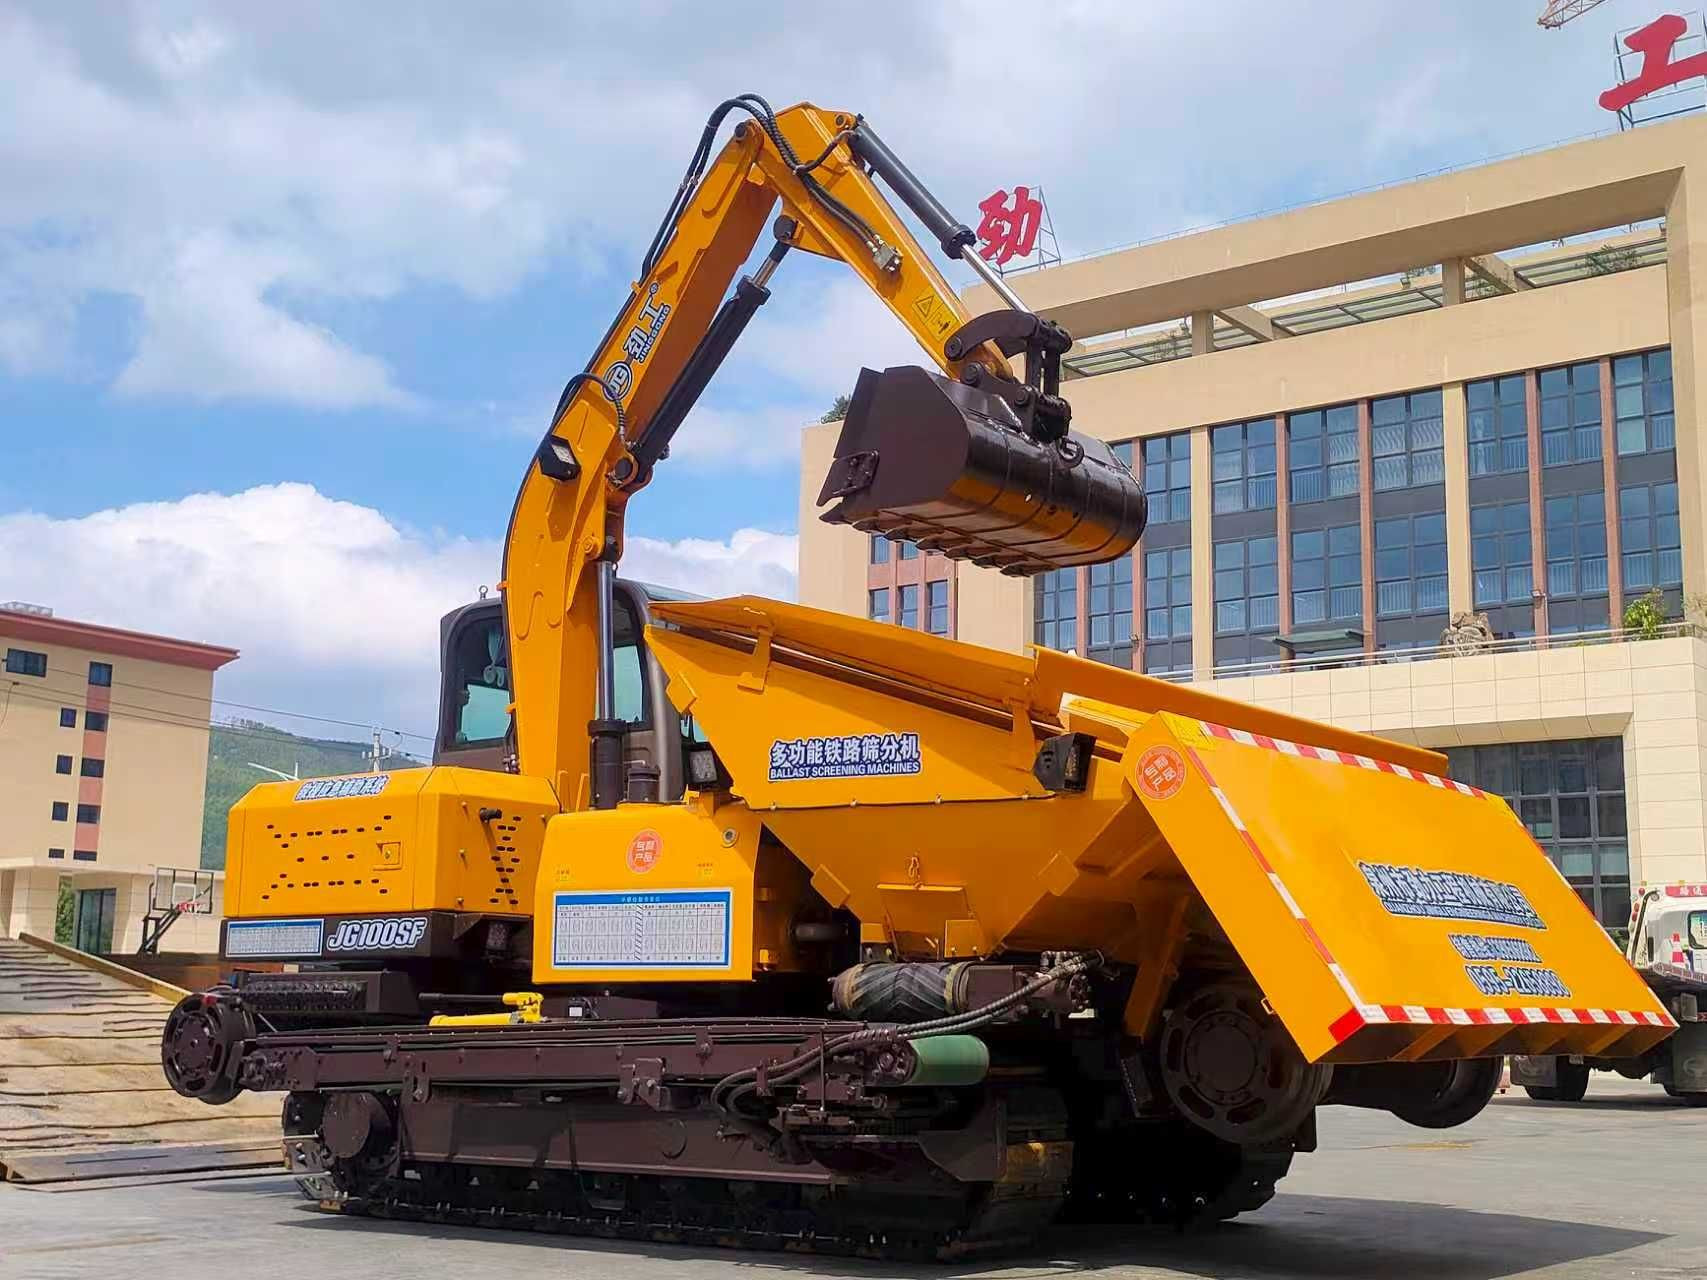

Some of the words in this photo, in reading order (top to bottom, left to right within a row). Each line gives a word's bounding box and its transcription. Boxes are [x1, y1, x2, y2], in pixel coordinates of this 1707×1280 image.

[976, 186, 1043, 265] 劲
[1599, 14, 1707, 112] 工
[622, 296, 664, 360] 劲工
[771, 734, 919, 768] 多功能铁路筛分机
[770, 765, 811, 779] BALLAST
[811, 763, 866, 777] SCREENING
[866, 760, 920, 775] MACHINES
[328, 919, 426, 949] JG100SF
